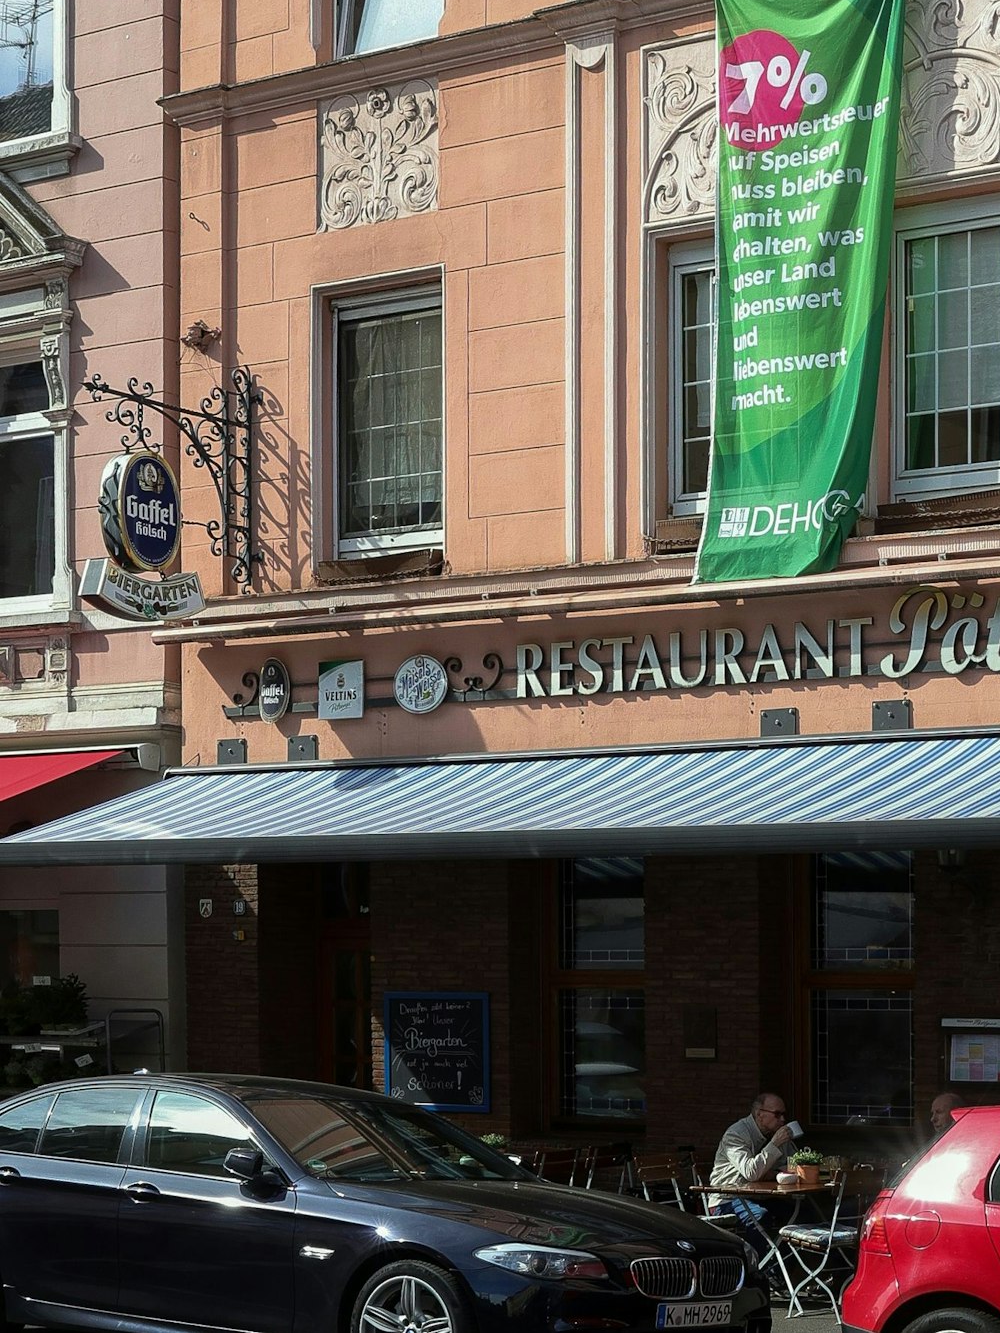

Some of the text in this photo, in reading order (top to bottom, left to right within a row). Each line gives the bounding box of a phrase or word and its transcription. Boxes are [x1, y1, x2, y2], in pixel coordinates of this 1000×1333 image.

[725, 50, 828, 115] 7%
[728, 140, 840, 174] uf Speisen
[781, 167, 869, 198] bleiben,
[732, 201, 821, 233] amit wir
[818, 227, 864, 247] was
[733, 256, 836, 293] unser Land
[733, 325, 758, 352] und
[732, 347, 847, 382] liebenswert
[731, 384, 792, 411] macht.
[126, 494, 177, 527] Gaffel
[135, 522, 167, 541] Kölsch
[107, 566, 198, 602] BIERGARTEN
[515, 617, 873, 700] RESTAURANT
[261, 682, 285, 697] Gaffel
[325, 689, 357, 702] VELTINS
[235, 901, 244, 913] 19
[404, 1027, 467, 1057] Biergarten
[665, 1304, 731, 1325] K MH 2969
